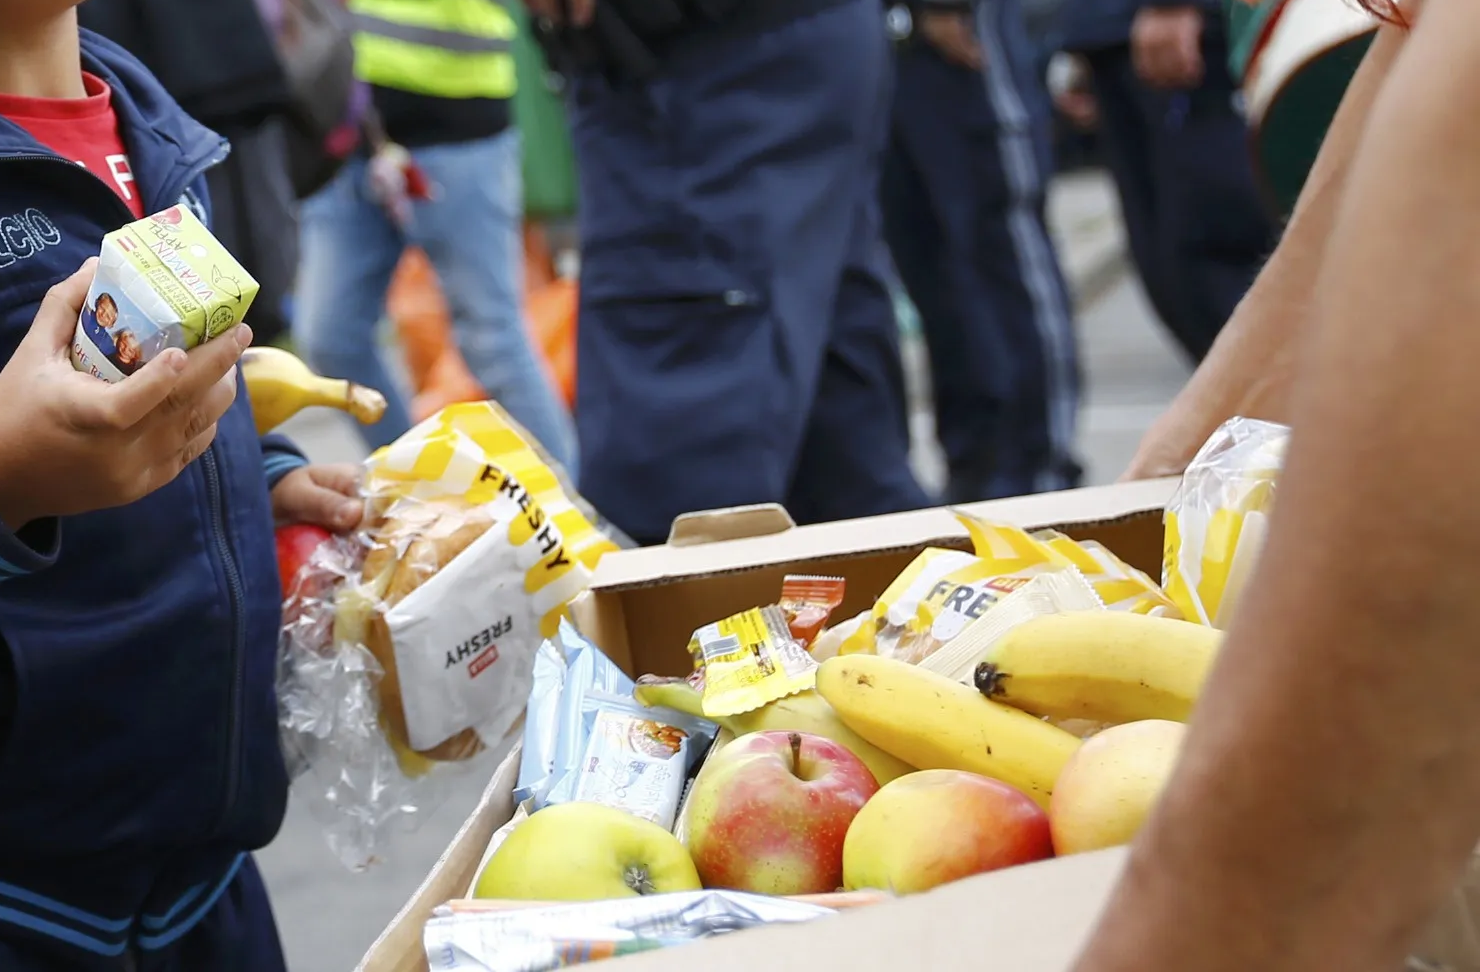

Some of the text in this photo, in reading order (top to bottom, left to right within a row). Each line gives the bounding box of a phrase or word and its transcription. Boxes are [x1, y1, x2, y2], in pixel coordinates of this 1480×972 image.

[149, 222, 188, 250] APFEL
[150, 241, 214, 301] VITAMIN
[479, 463, 571, 570] FRESHY
[925, 580, 998, 619] FRE
[445, 615, 514, 669] FRESHY
